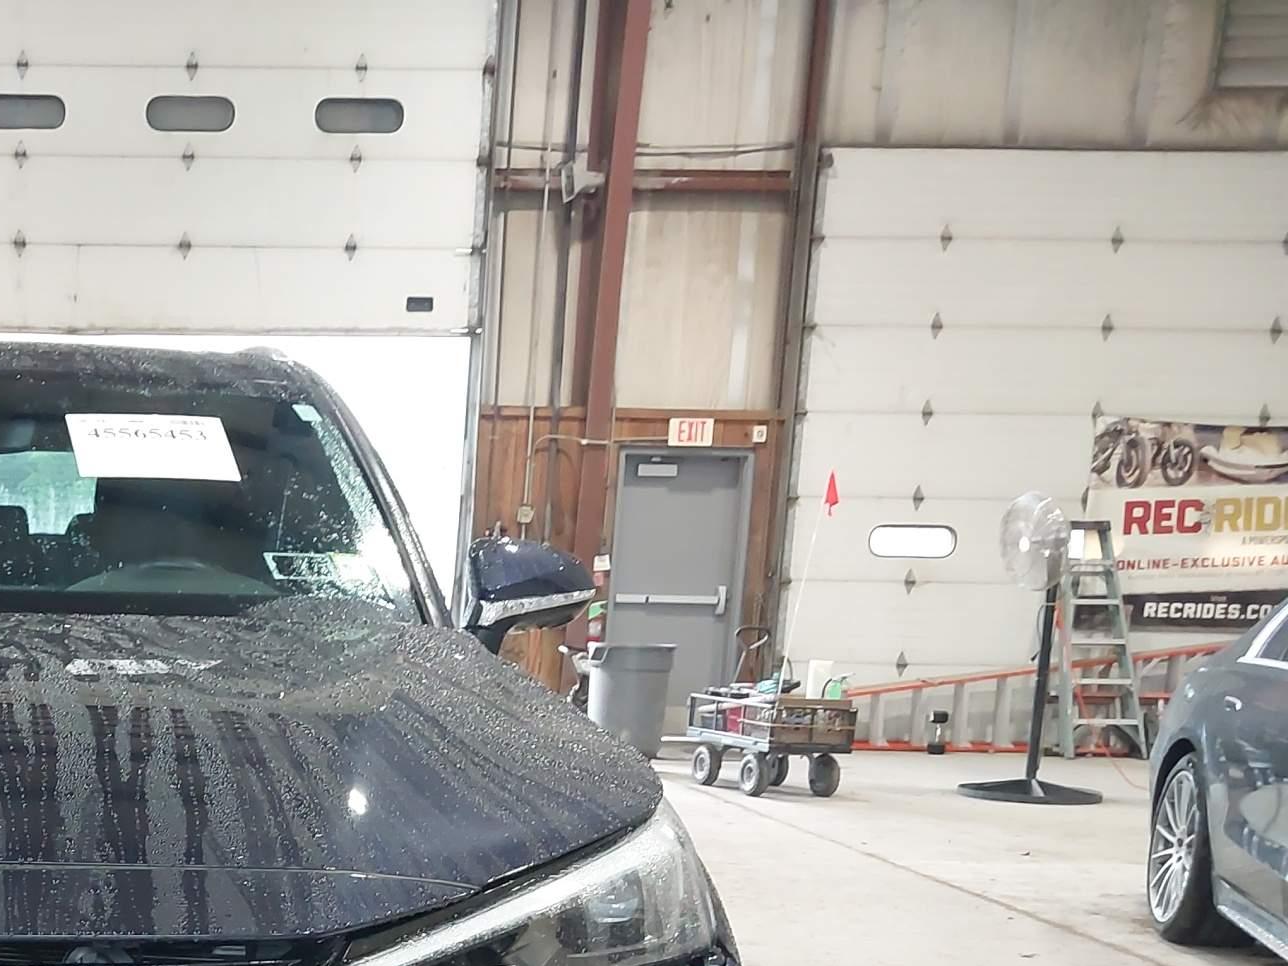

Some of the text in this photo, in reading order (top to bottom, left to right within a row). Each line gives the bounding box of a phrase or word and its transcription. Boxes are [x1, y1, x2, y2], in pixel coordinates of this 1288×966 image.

[87, 428, 208, 441] 45565453
[678, 420, 706, 442] EXIT
[1123, 496, 1288, 535] REC RID
[1116, 555, 1265, 571] ONLINE-EXCLUSIVE
[1143, 602, 1279, 619] RECRIDES.CO
